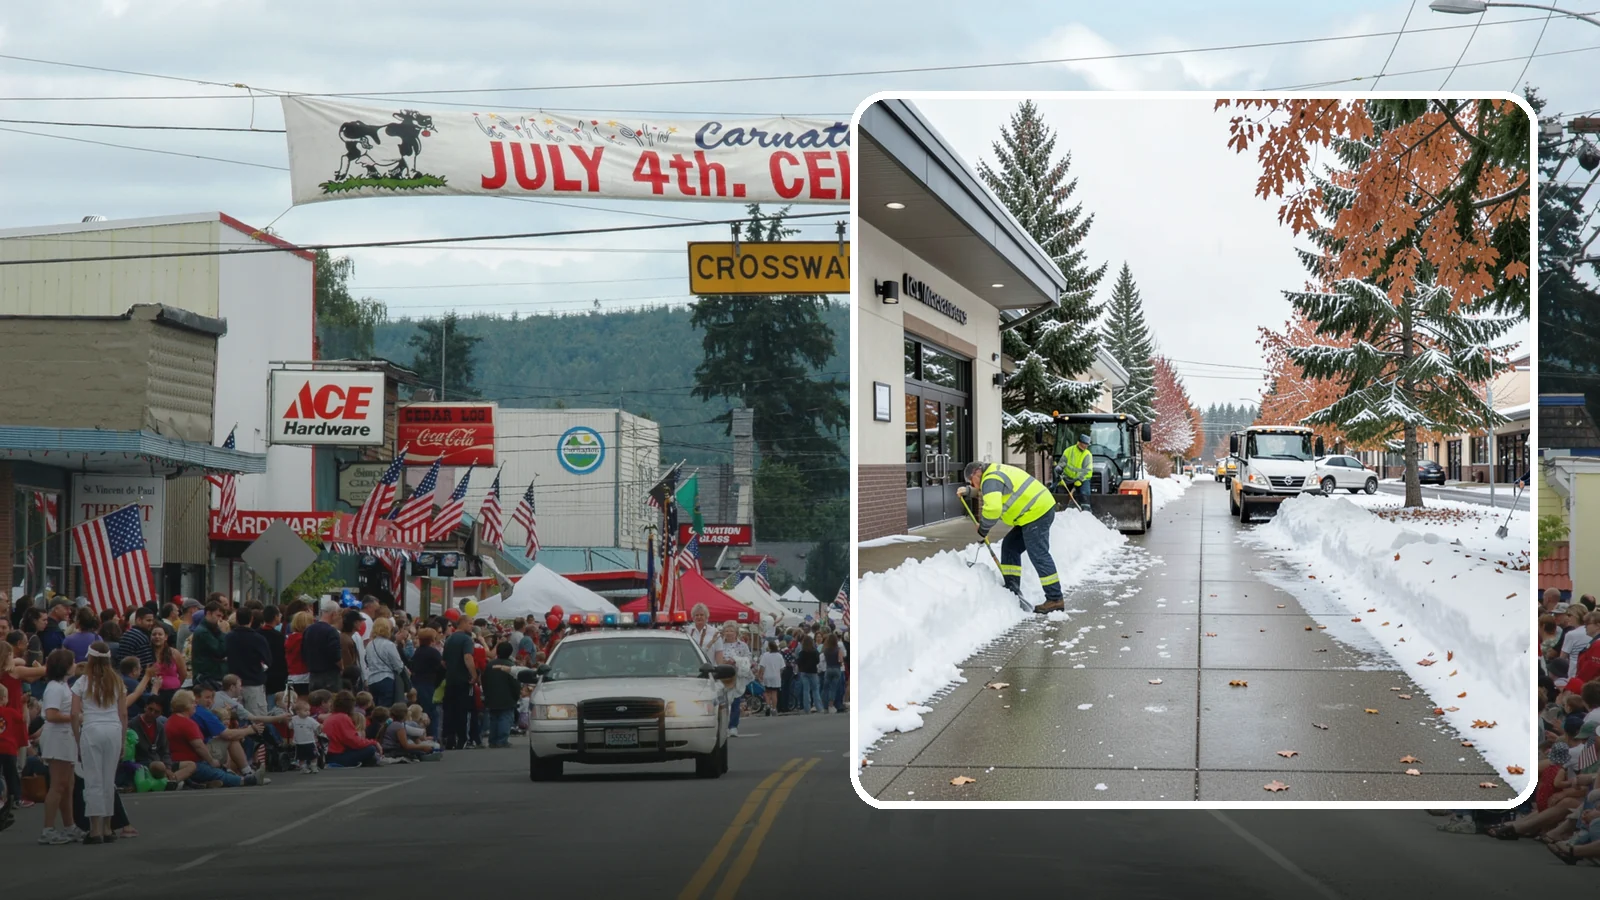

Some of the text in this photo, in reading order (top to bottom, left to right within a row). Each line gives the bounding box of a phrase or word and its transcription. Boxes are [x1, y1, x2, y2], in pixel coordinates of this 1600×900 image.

[694, 121, 850, 150] Carnat
[481, 141, 605, 193] JULY
[632, 150, 747, 198] 4th.
[697, 254, 850, 280] CROSSWA
[282, 380, 374, 420] ACE
[406, 409, 485, 422] CEDAR LOG
[283, 421, 371, 437] Hardware
[416, 428, 477, 447] Coca-Cola
[353, 467, 385, 480] Simpl
[96, 485, 124, 495] Vincent
[126, 486, 136, 495] de
[137, 486, 155, 495] Paul
[212, 516, 331, 535] HARDARE
[688, 526, 742, 535] CRNATION
[699, 535, 730, 543] GLASS
